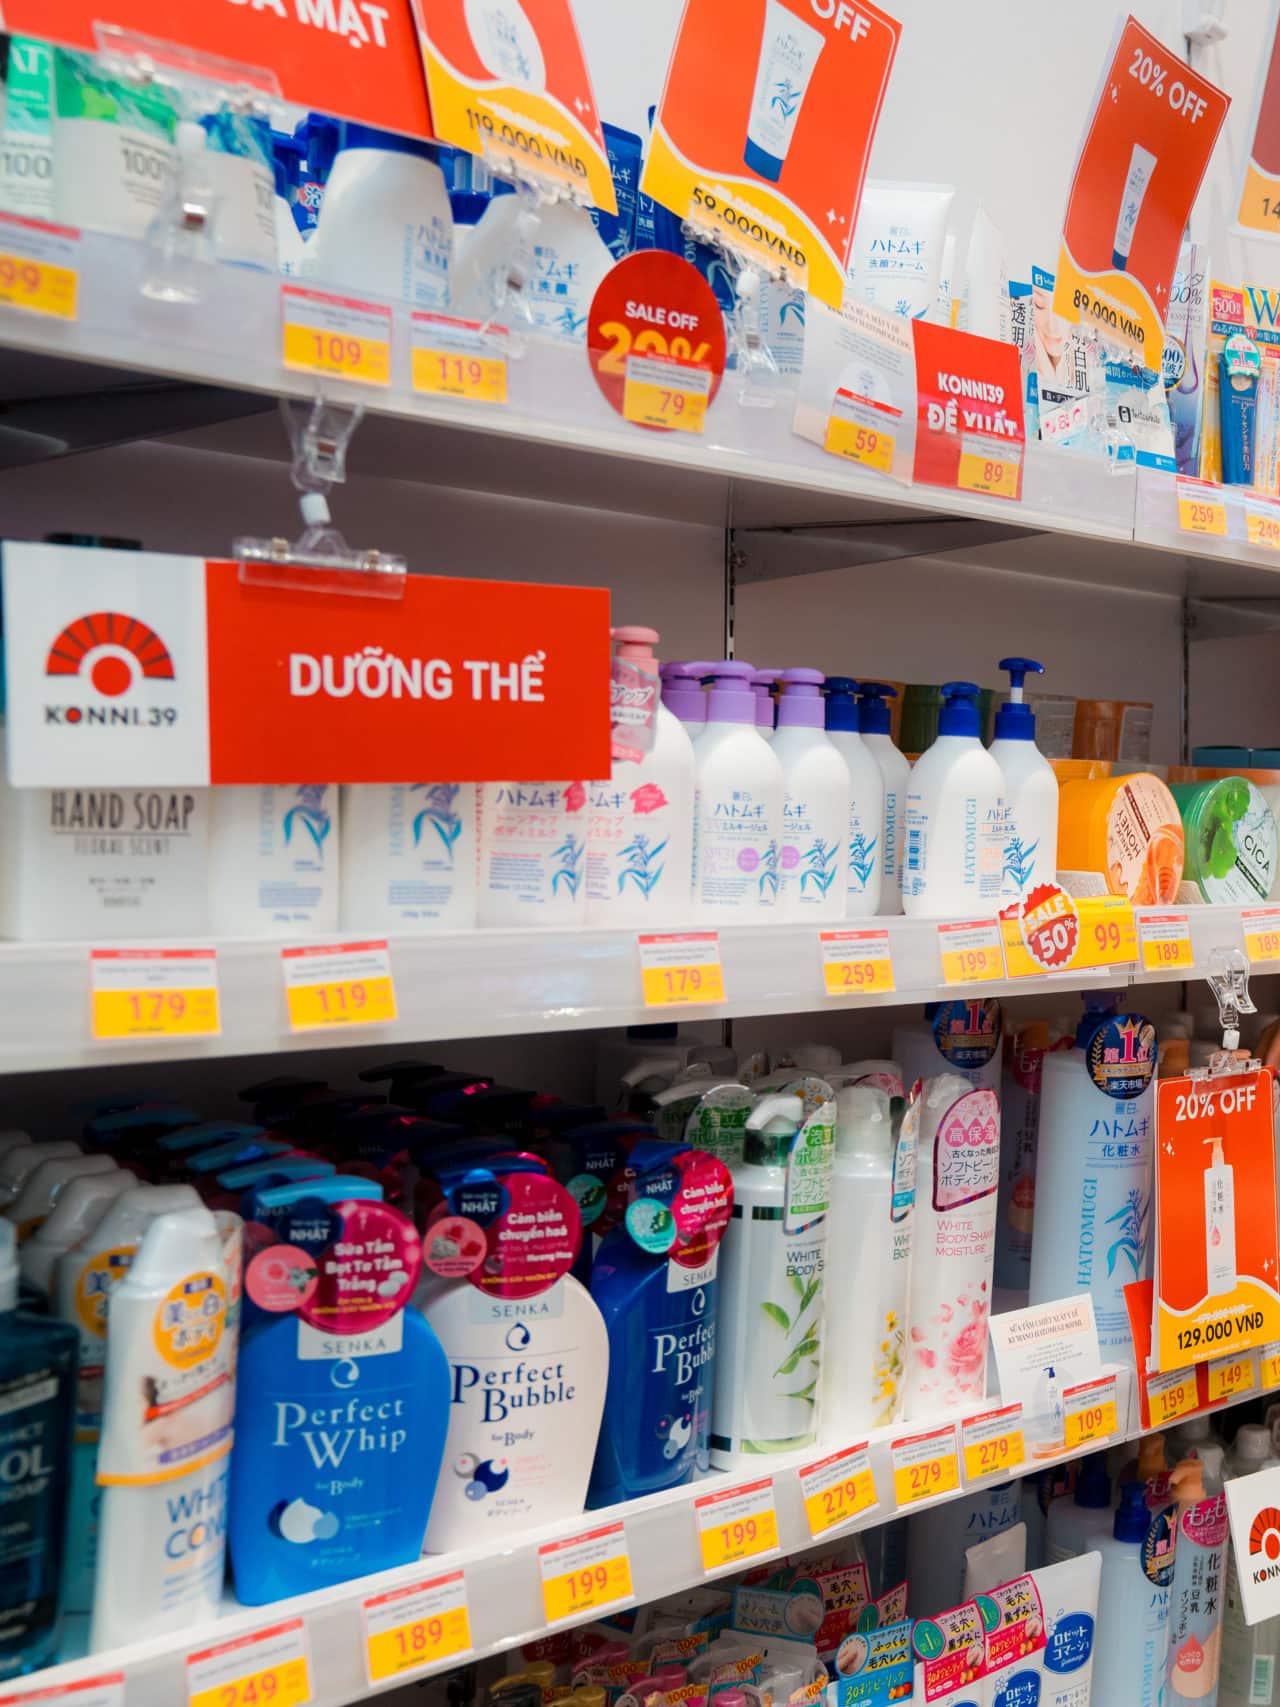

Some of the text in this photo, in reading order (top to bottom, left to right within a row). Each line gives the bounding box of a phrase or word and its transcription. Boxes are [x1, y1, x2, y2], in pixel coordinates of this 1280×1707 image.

[811, 0, 871, 42] OFF
[1128, 48, 1208, 124] 20% OFF
[466, 107, 541, 157] 119.000
[546, 144, 588, 178] VNĐ
[870, 238, 927, 255] ハトムギ
[625, 300, 699, 332] SALE OFF
[1073, 288, 1117, 328] 89.000
[313, 334, 363, 366] 109
[438, 357, 483, 386] 119
[937, 372, 1005, 405] KONNI39
[658, 391, 686, 416] 79
[927, 400, 958, 434] ĐỀ
[855, 432, 878, 452] 59
[984, 462, 1004, 483] 89
[1191, 505, 1214, 523] 259
[1258, 520, 1280, 540] 249
[289, 646, 547, 702] DƯỠNG THỂ
[45, 705, 177, 727] KONNI.39
[50, 790, 195, 831] HAND SOAP
[496, 788, 560, 808] ハトムギ
[714, 802, 766, 818] ハトムギ
[884, 791, 897, 876] HATOMUGI
[964, 797, 977, 885] HATOMUGI
[1117, 809, 1142, 858] HONEY
[1244, 834, 1270, 874] CICA
[1022, 892, 1066, 928] SALE
[1094, 922, 1121, 952] 99
[1257, 933, 1280, 951] 189
[957, 950, 987, 972] 199
[1156, 942, 1179, 961] 189
[664, 968, 702, 993] 179
[841, 963, 876, 985] 259
[129, 993, 187, 1021] 179
[317, 983, 367, 1013] 119
[1175, 1086, 1257, 1121] 20% OFF
[1101, 1143, 1141, 1158] 化粧水
[937, 1218, 973, 1231] WHITE
[937, 1231, 968, 1244] BODY
[1077, 1177, 1099, 1286] HATOMUGI
[786, 1248, 822, 1264] WHITE
[936, 1244, 986, 1257] MOISTURE
[786, 1263, 817, 1278] BODY
[491, 1301, 550, 1319] SENKA
[1177, 1318, 1233, 1351] 129.000
[1235, 1311, 1264, 1338] VNĐ
[322, 1337, 388, 1355] SENKA
[452, 1362, 565, 1405] Perfect
[1220, 1364, 1242, 1387] 149
[480, 1382, 577, 1425] Bubble
[1160, 1387, 1185, 1412] 159
[271, 1396, 405, 1449] Perfect
[1077, 1407, 1103, 1433] 109
[302, 1426, 407, 1471] Whip
[504, 1428, 536, 1448] Body
[979, 1438, 1009, 1465] 279
[329, 1476, 364, 1497] Body
[909, 1462, 941, 1490] 279
[823, 1480, 857, 1515] 279
[721, 1519, 757, 1549] 199
[567, 1566, 608, 1601] 199
[1203, 1552, 1222, 1616] 化粧水
[394, 1618, 443, 1655] 189
[1053, 1626, 1089, 1647] ロゼット
[221, 1676, 277, 1707] 249
